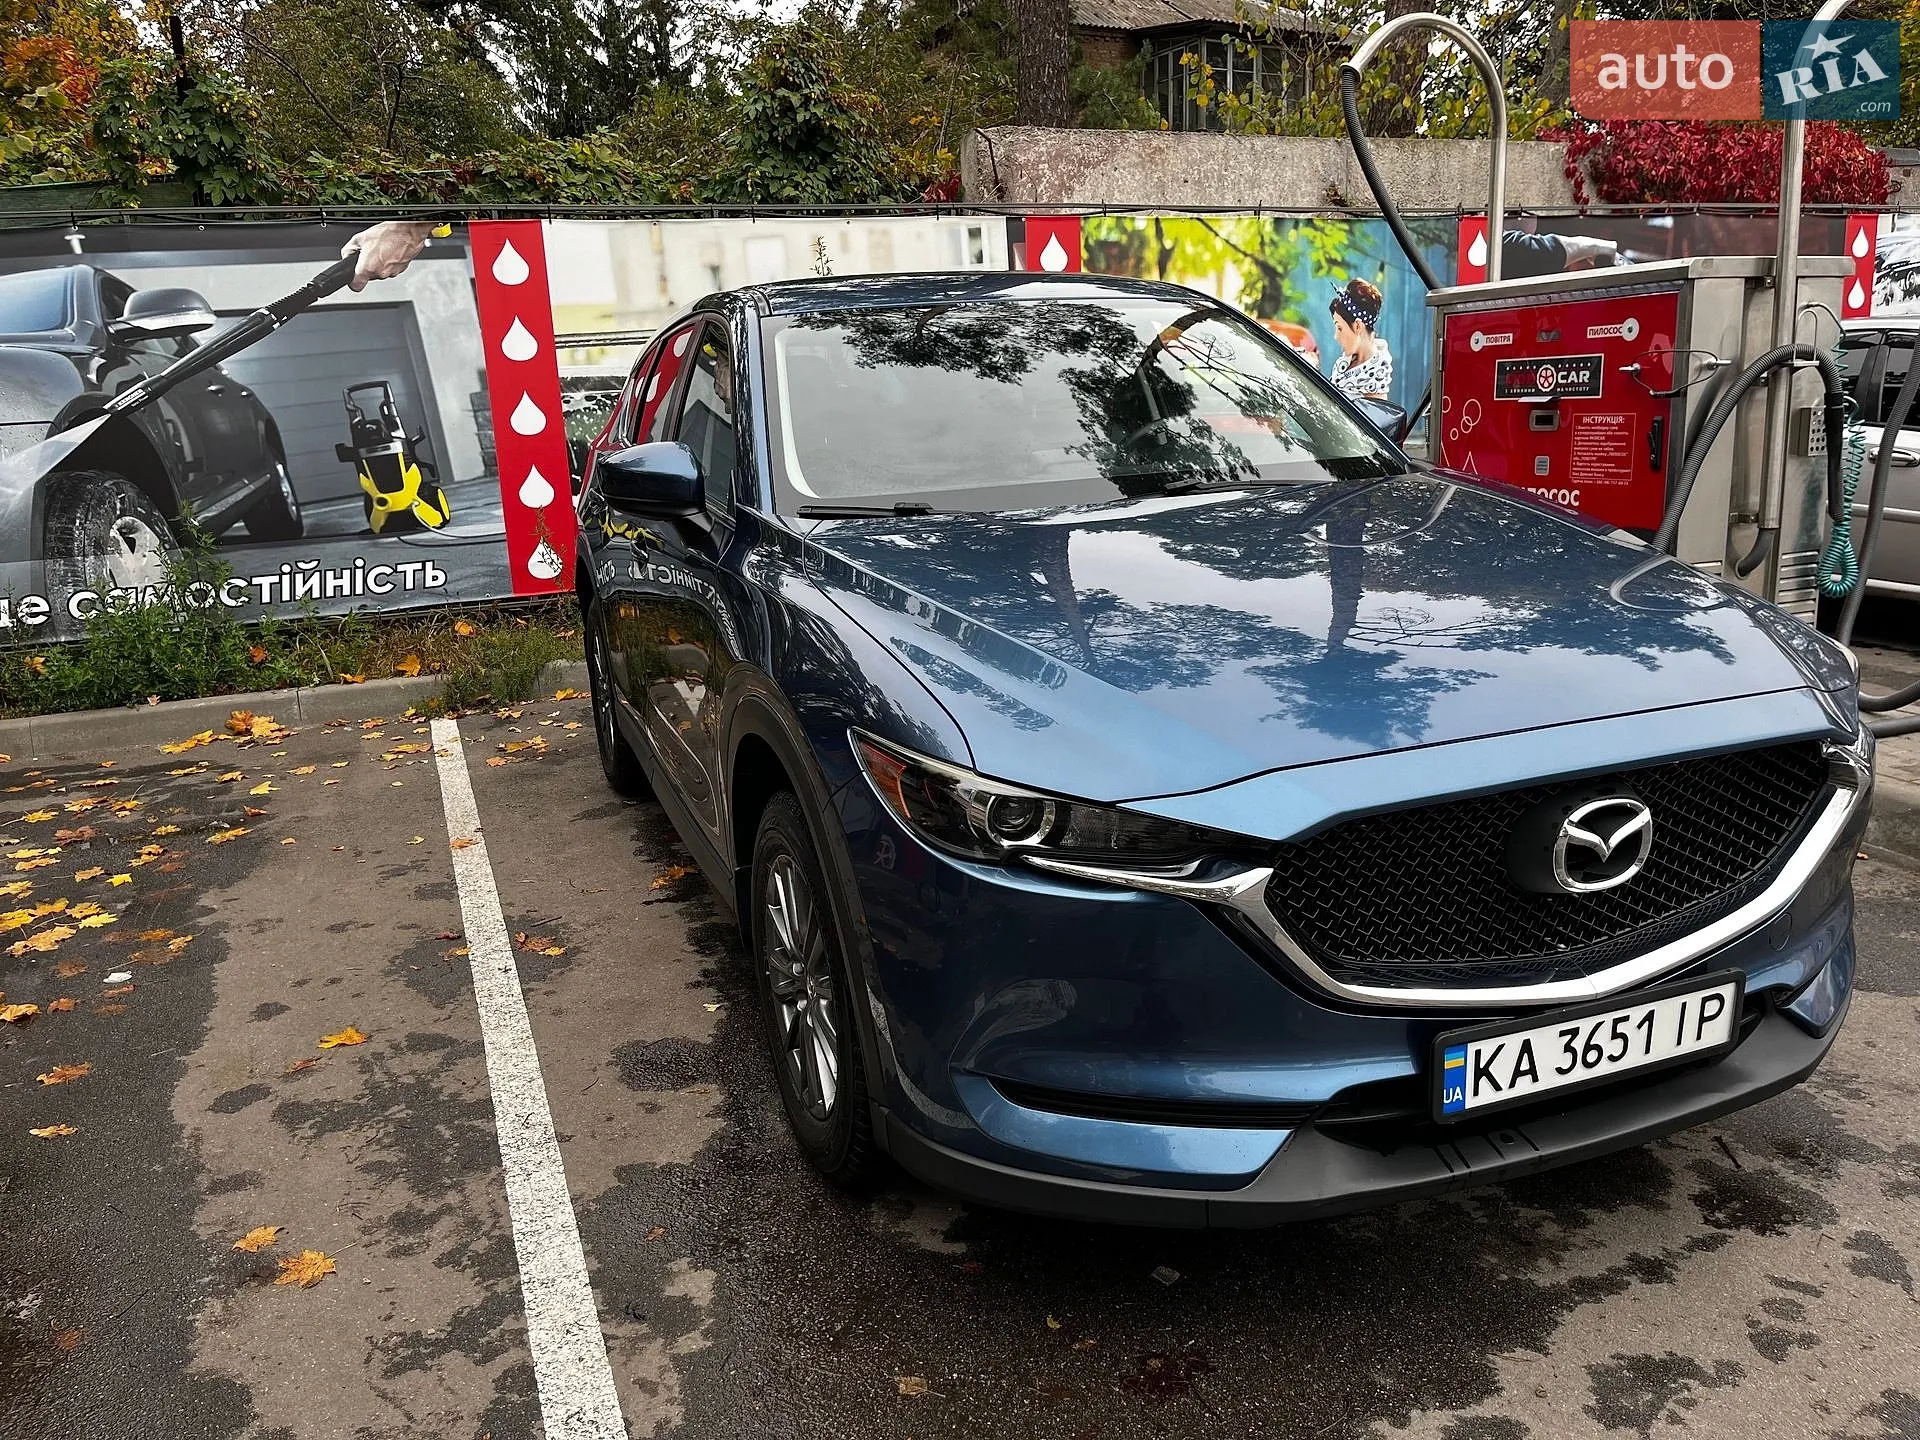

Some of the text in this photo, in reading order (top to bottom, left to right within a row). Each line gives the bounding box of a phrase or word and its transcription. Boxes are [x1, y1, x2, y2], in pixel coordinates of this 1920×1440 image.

[1588, 325, 1622, 337] ПИЛОСОС
[1485, 334, 1511, 345] ПОВІТРЯ
[1557, 370, 1590, 384] CAR
[1582, 415, 1625, 425] ІНСТРУКЦІЯ:
[1472, 1038, 1540, 1098] KA
[1555, 1008, 1656, 1076] 3651
[1443, 1088, 1463, 1104] UA
